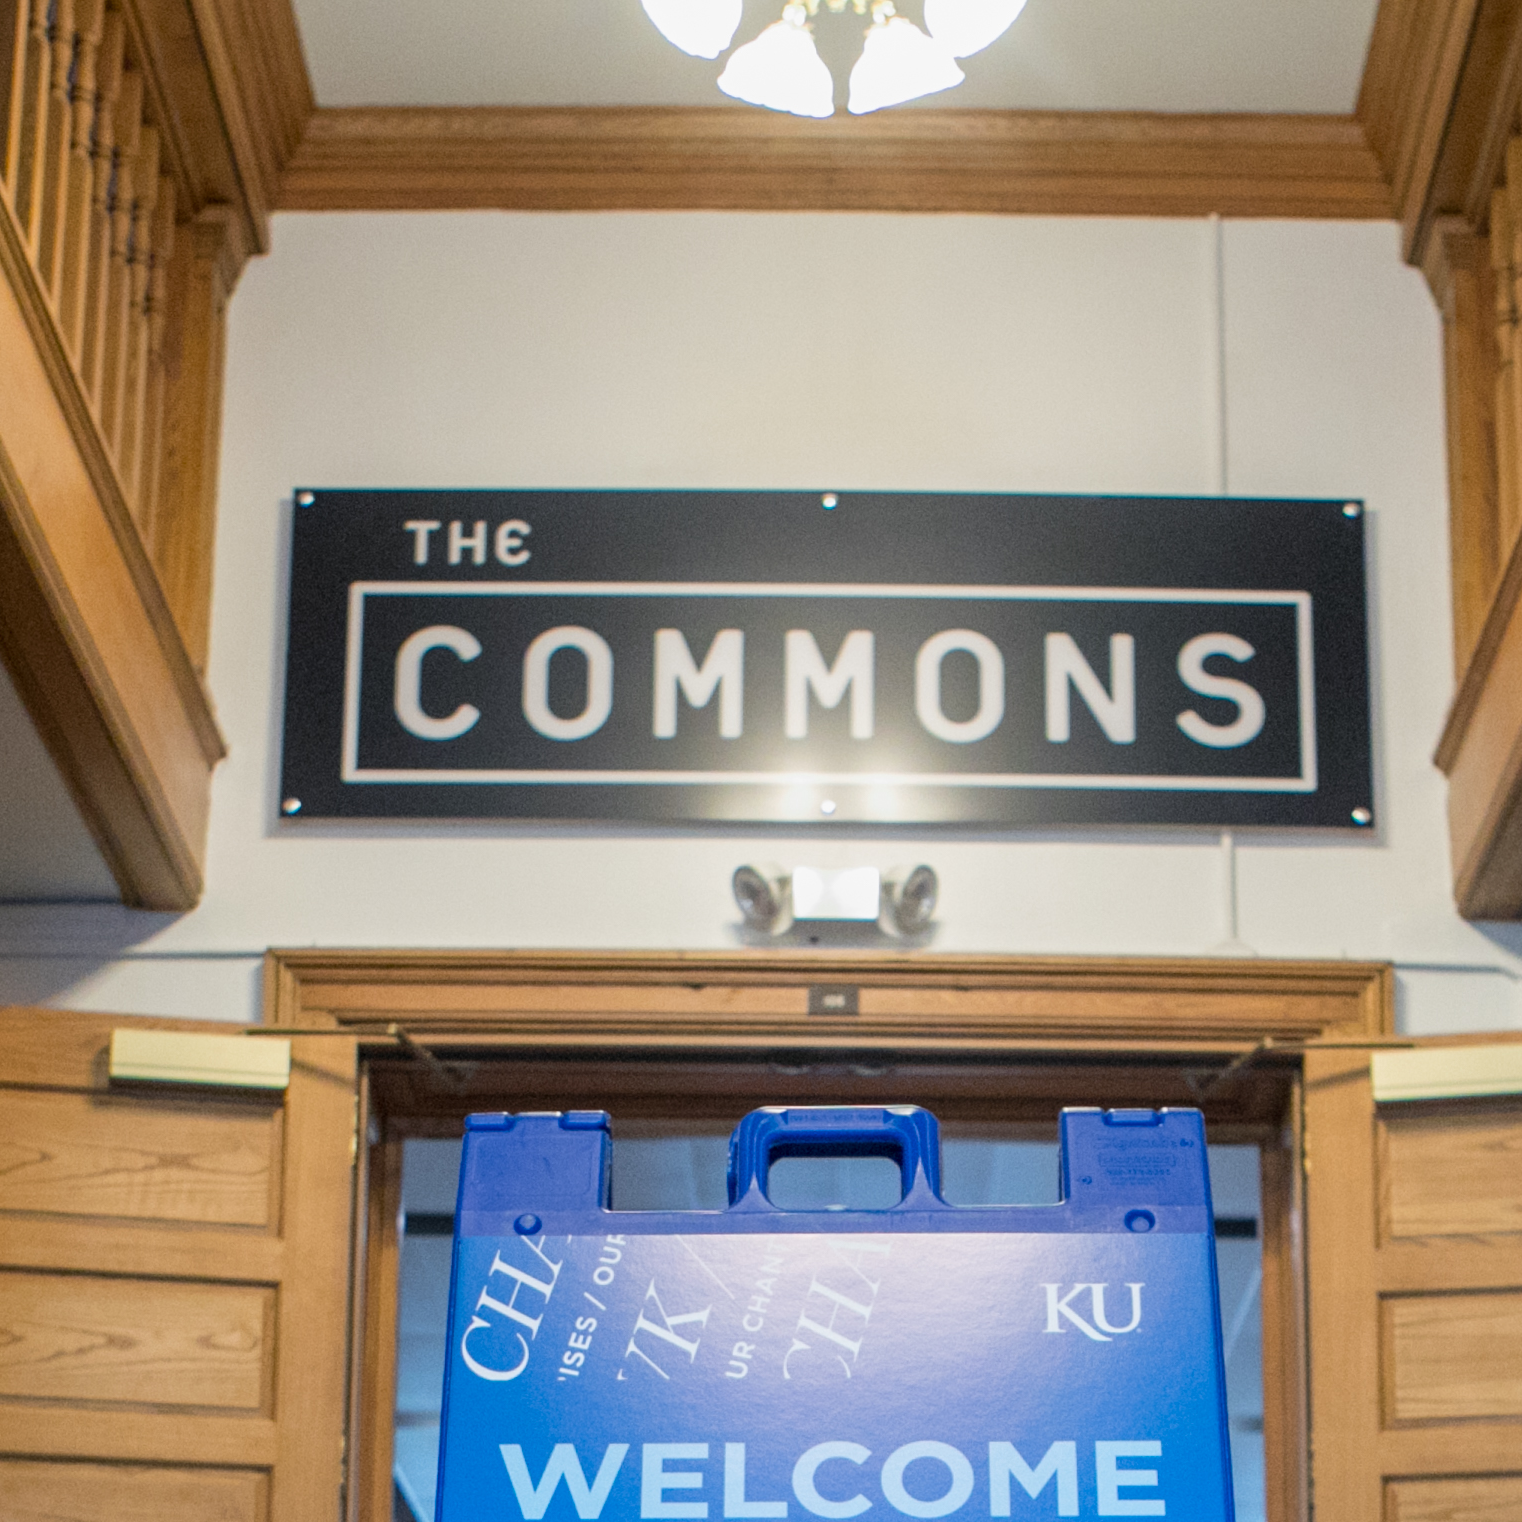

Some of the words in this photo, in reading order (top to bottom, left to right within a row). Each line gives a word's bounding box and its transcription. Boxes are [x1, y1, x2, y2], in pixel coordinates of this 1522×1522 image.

[404, 520, 533, 566] THE
[393, 625, 1267, 749] COMMONS
[1038, 1282, 1146, 1342] KU
[498, 1439, 1167, 1521] WELCOME
